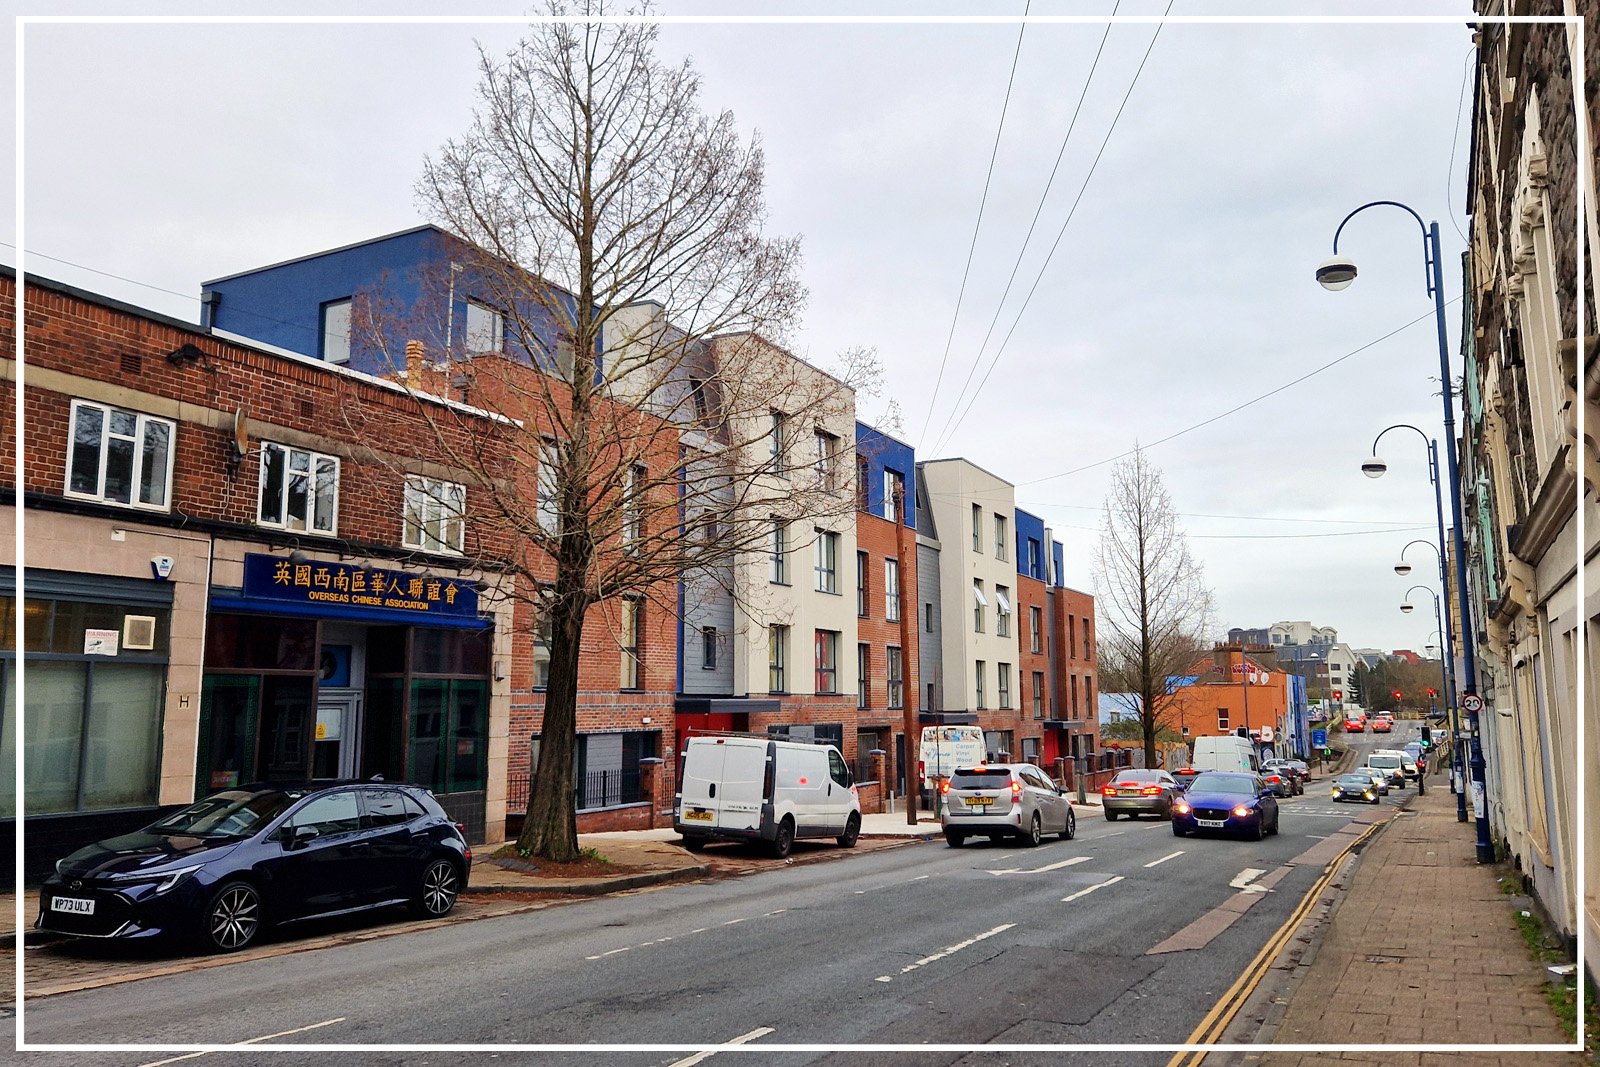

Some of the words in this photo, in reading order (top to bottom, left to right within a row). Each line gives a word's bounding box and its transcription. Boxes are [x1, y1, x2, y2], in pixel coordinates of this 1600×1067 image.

[273, 561, 459, 604] 英國西南區華人聯誼會
[308, 591, 350, 603] OVERSEAS
[351, 594, 383, 606] CHINESE
[384, 598, 429, 610] ASSOCIATION
[179, 695, 189, 708] H
[1466, 699, 1480, 707] 20
[54, 898, 74, 911] WP73
[74, 900, 92, 912] ULX
